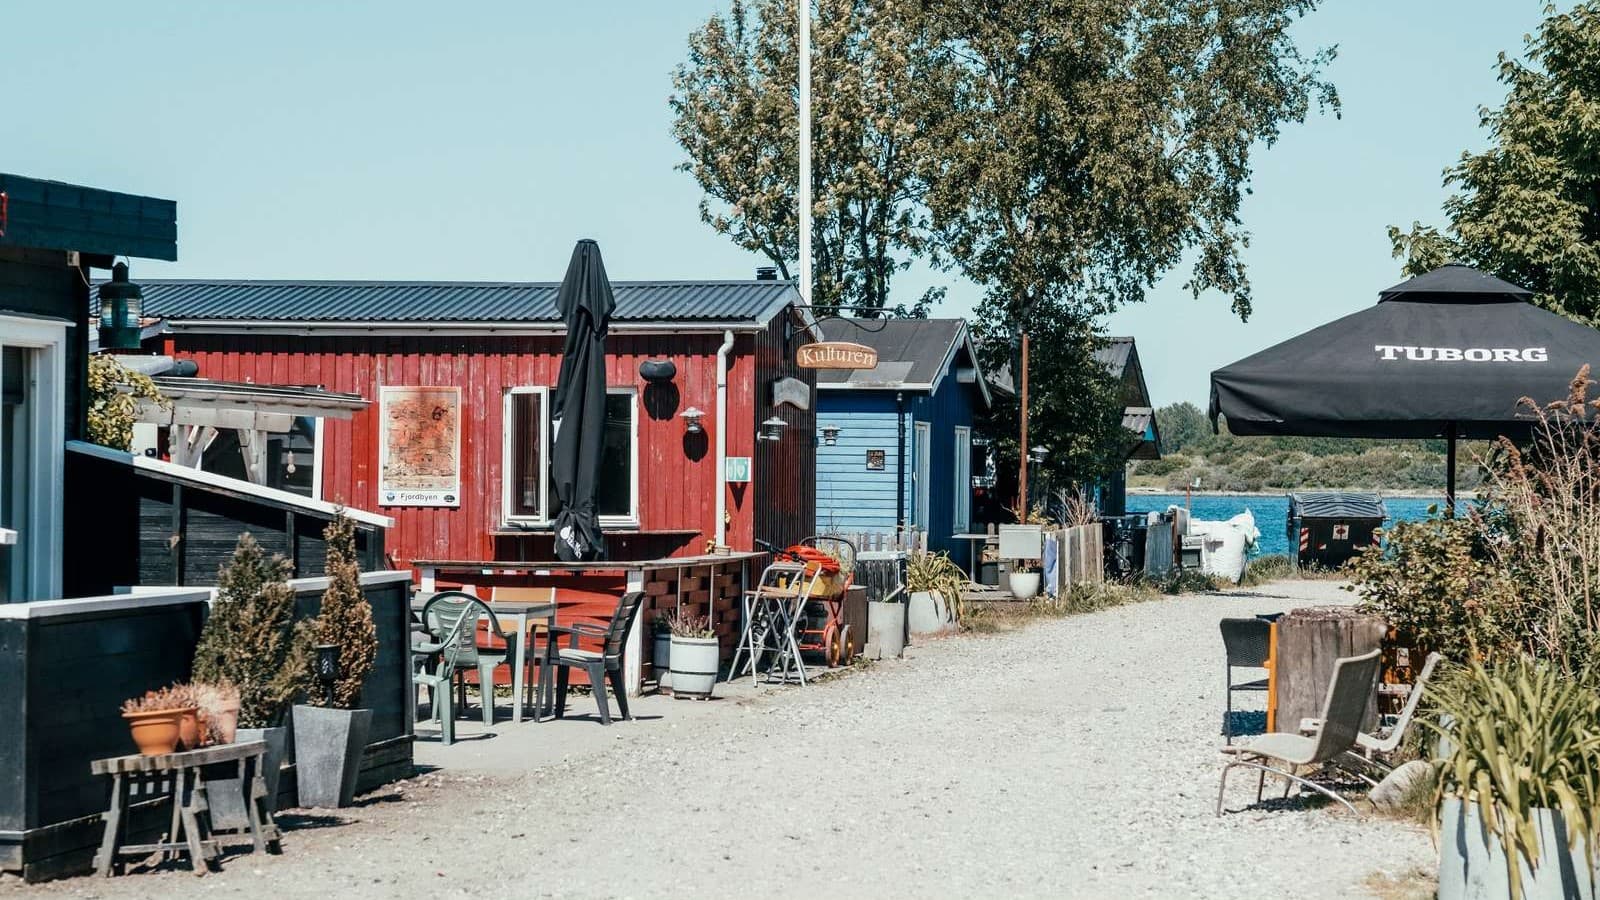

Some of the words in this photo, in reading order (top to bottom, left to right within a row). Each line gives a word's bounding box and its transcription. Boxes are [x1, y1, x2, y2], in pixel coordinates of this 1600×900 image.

[802, 346, 873, 365] Kulturen
[1374, 344, 1549, 362] TUBORG
[400, 493, 438, 501] Fjordbyen
